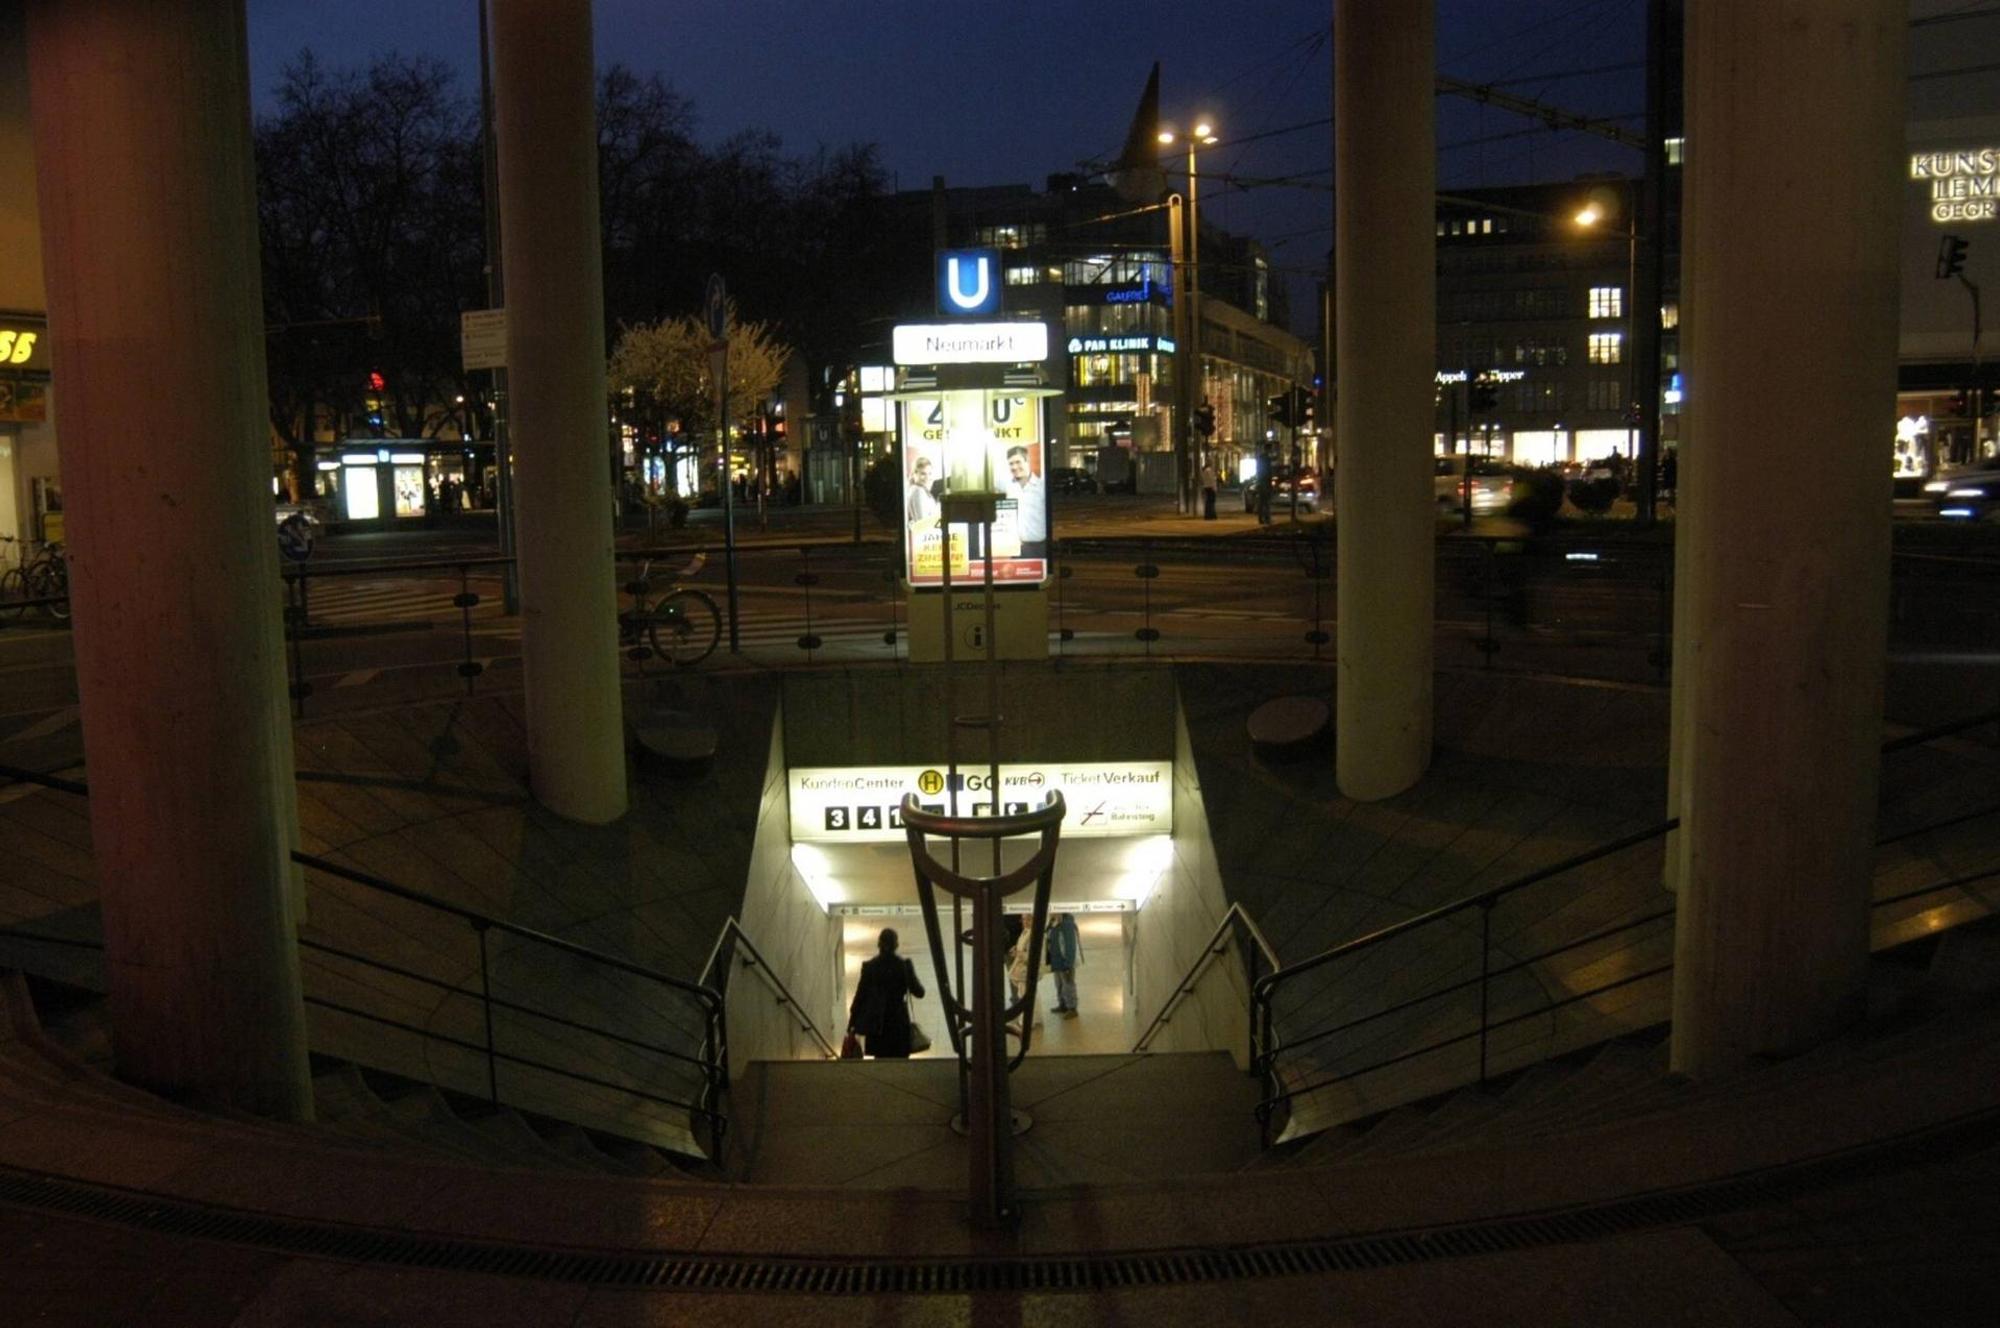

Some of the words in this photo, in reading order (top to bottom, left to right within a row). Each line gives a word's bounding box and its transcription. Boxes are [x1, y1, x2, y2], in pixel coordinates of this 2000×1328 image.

[1911, 149, 2000, 179] KUNS
[1932, 175, 2000, 201] LEM
[947, 257, 989, 308] U
[926, 335, 1014, 351] Neumarkt
[1109, 337, 1149, 351] KLINIK
[831, 809, 844, 827] 3
[863, 808, 876, 826] 4
